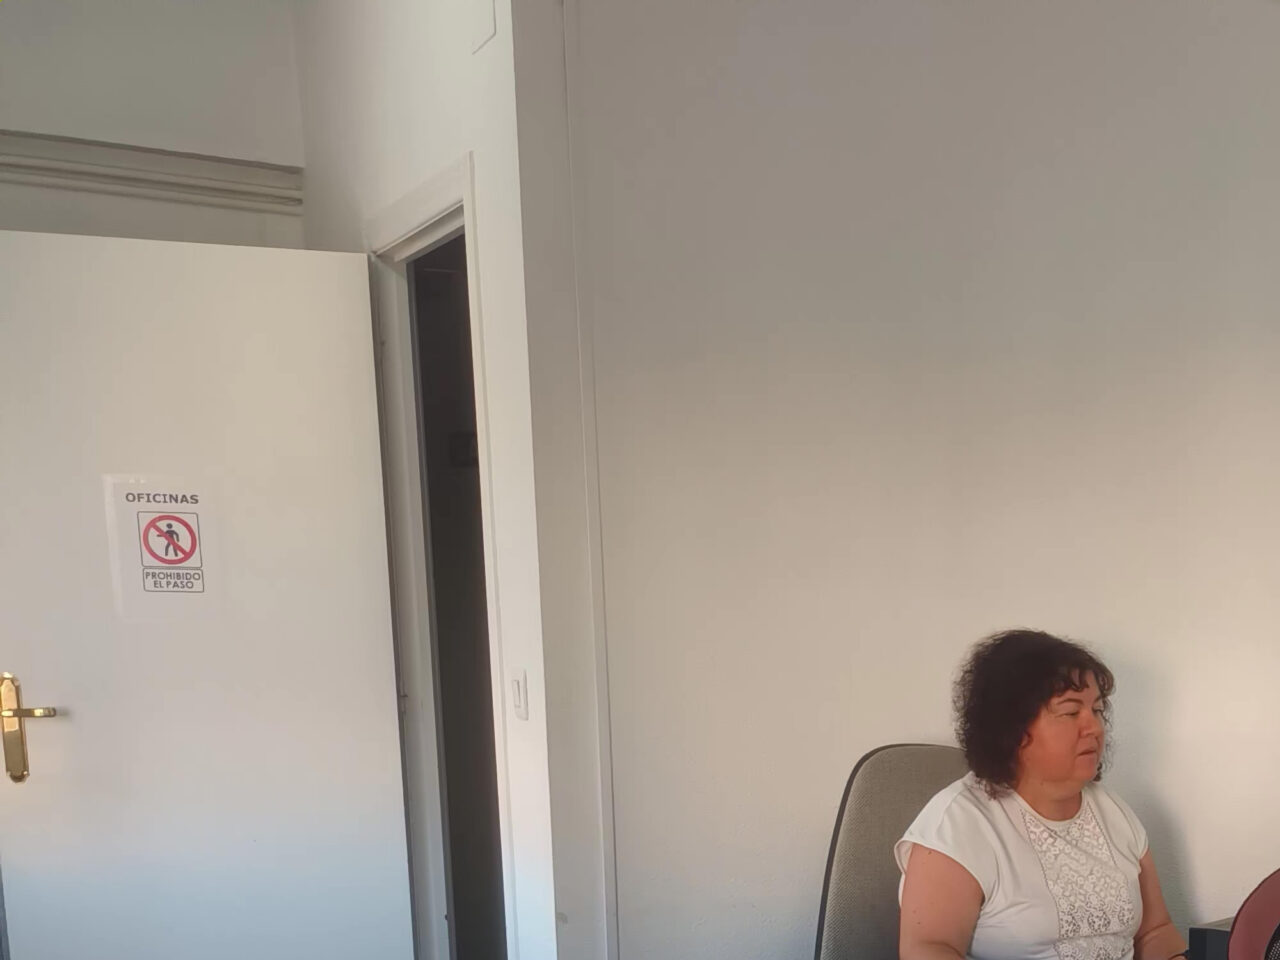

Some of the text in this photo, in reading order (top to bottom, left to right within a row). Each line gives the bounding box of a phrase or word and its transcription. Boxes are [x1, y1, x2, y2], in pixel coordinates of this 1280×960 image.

[126, 493, 199, 504] OFICINAS
[146, 572, 200, 580] PROHIBIDO
[166, 581, 194, 589] PASO
